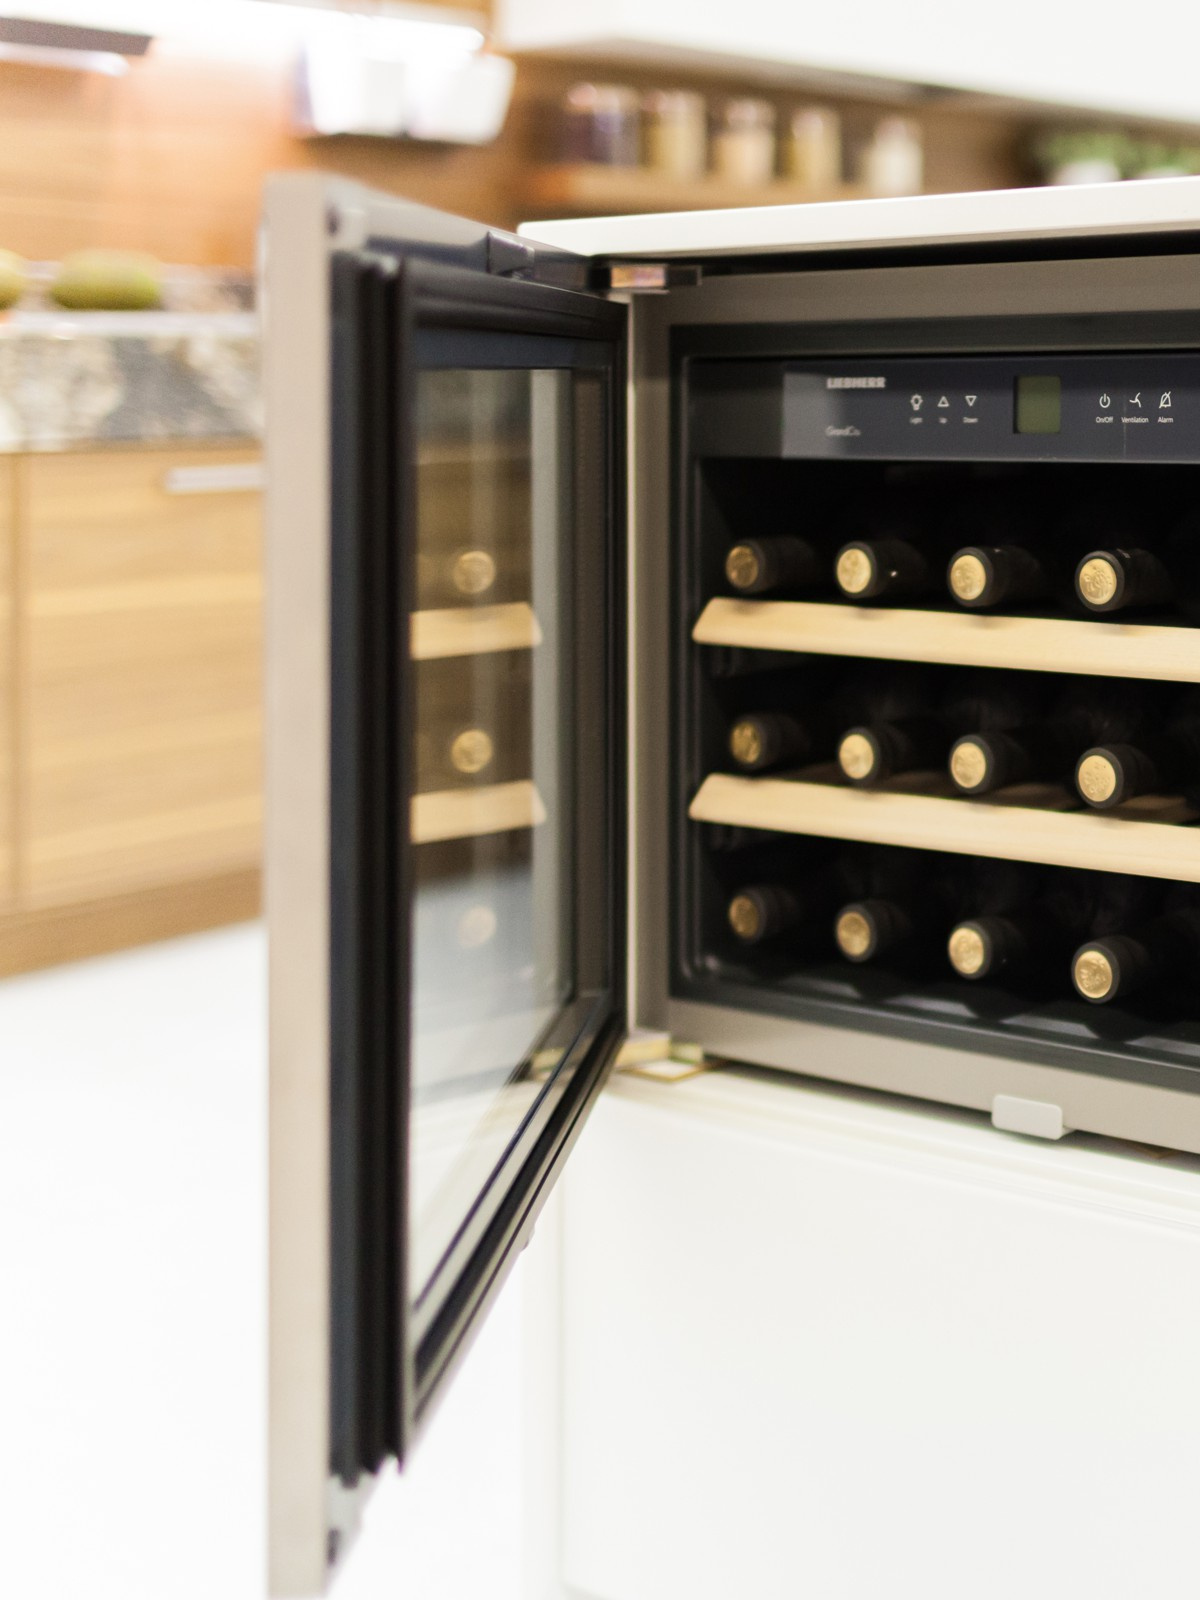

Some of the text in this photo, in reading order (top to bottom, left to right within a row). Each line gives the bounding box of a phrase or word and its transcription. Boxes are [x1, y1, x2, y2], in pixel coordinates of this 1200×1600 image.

[1095, 416, 1114, 424] On/Off
[1121, 416, 1149, 424] Ventilation
[1157, 416, 1174, 424] Alarm
